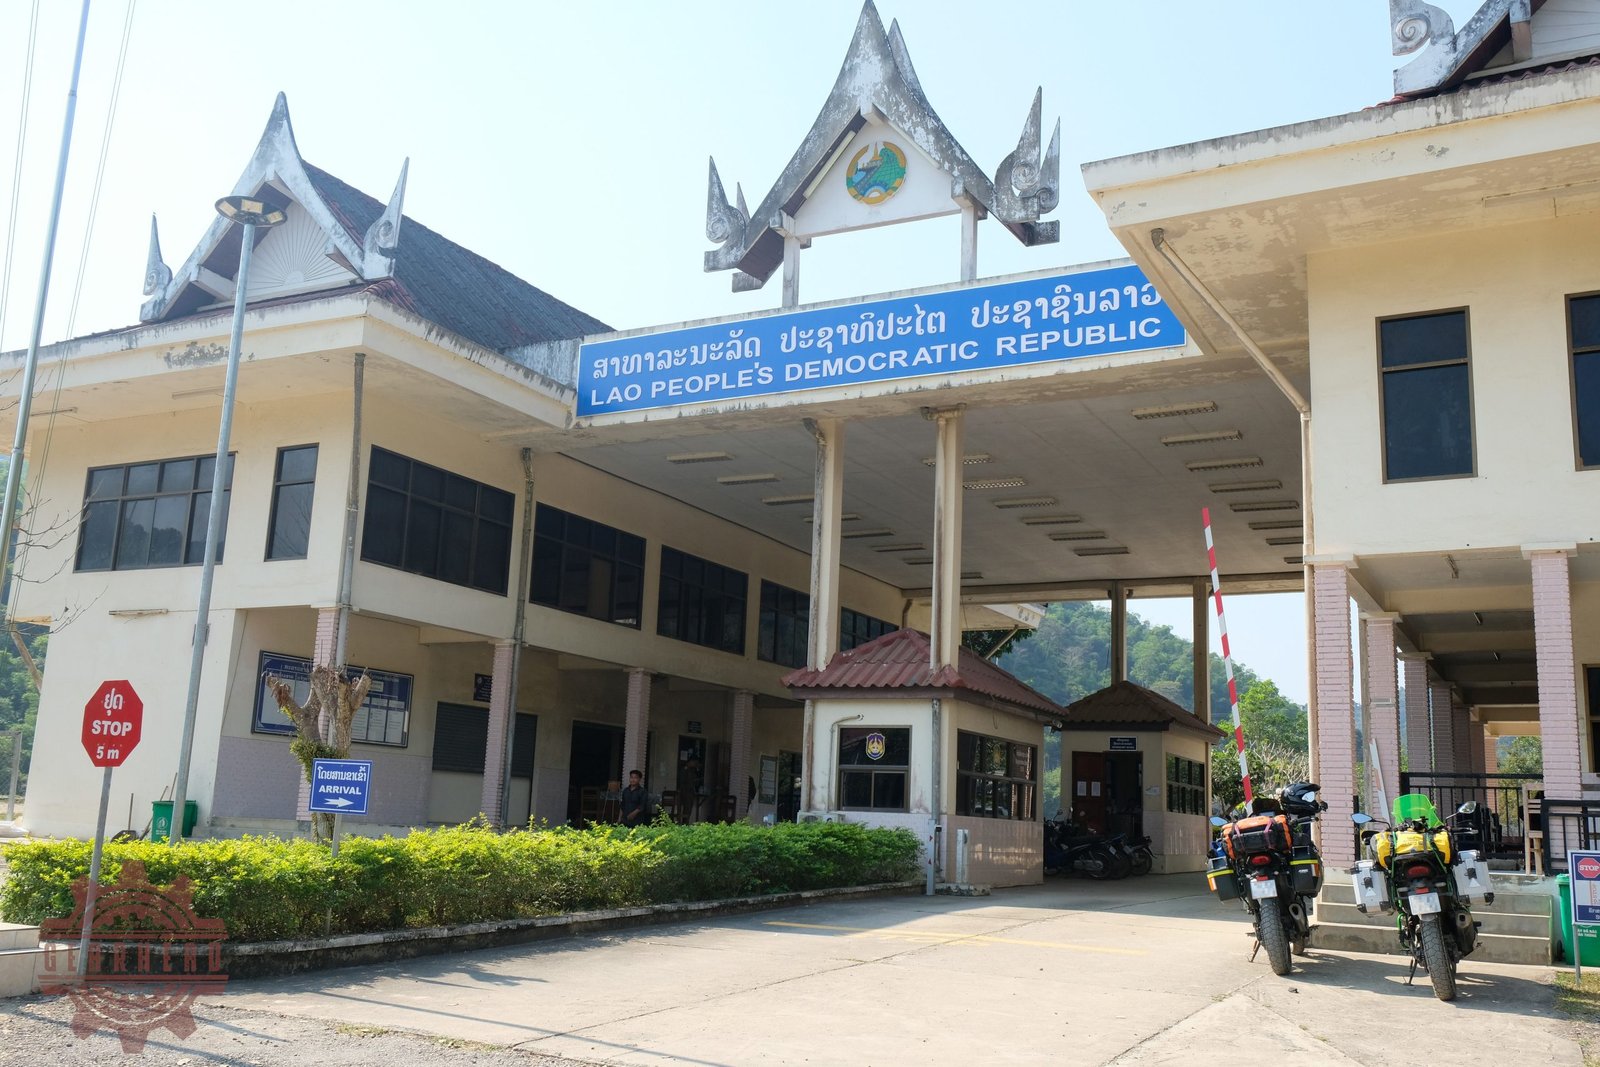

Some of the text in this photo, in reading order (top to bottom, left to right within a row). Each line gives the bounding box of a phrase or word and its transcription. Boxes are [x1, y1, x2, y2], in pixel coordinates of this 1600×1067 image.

[592, 329, 762, 380] ສາທາລະນະລັດ
[779, 303, 947, 355] ປະຊາທິປະໄຕ
[590, 317, 1162, 407] LAO PEOPLE'S DEMOCRATIC REPUBLIC
[91, 719, 133, 737] STOP
[96, 745, 120, 760] 5 m
[318, 784, 362, 795] ARRIVAL
[1579, 864, 1600, 872] STOP
